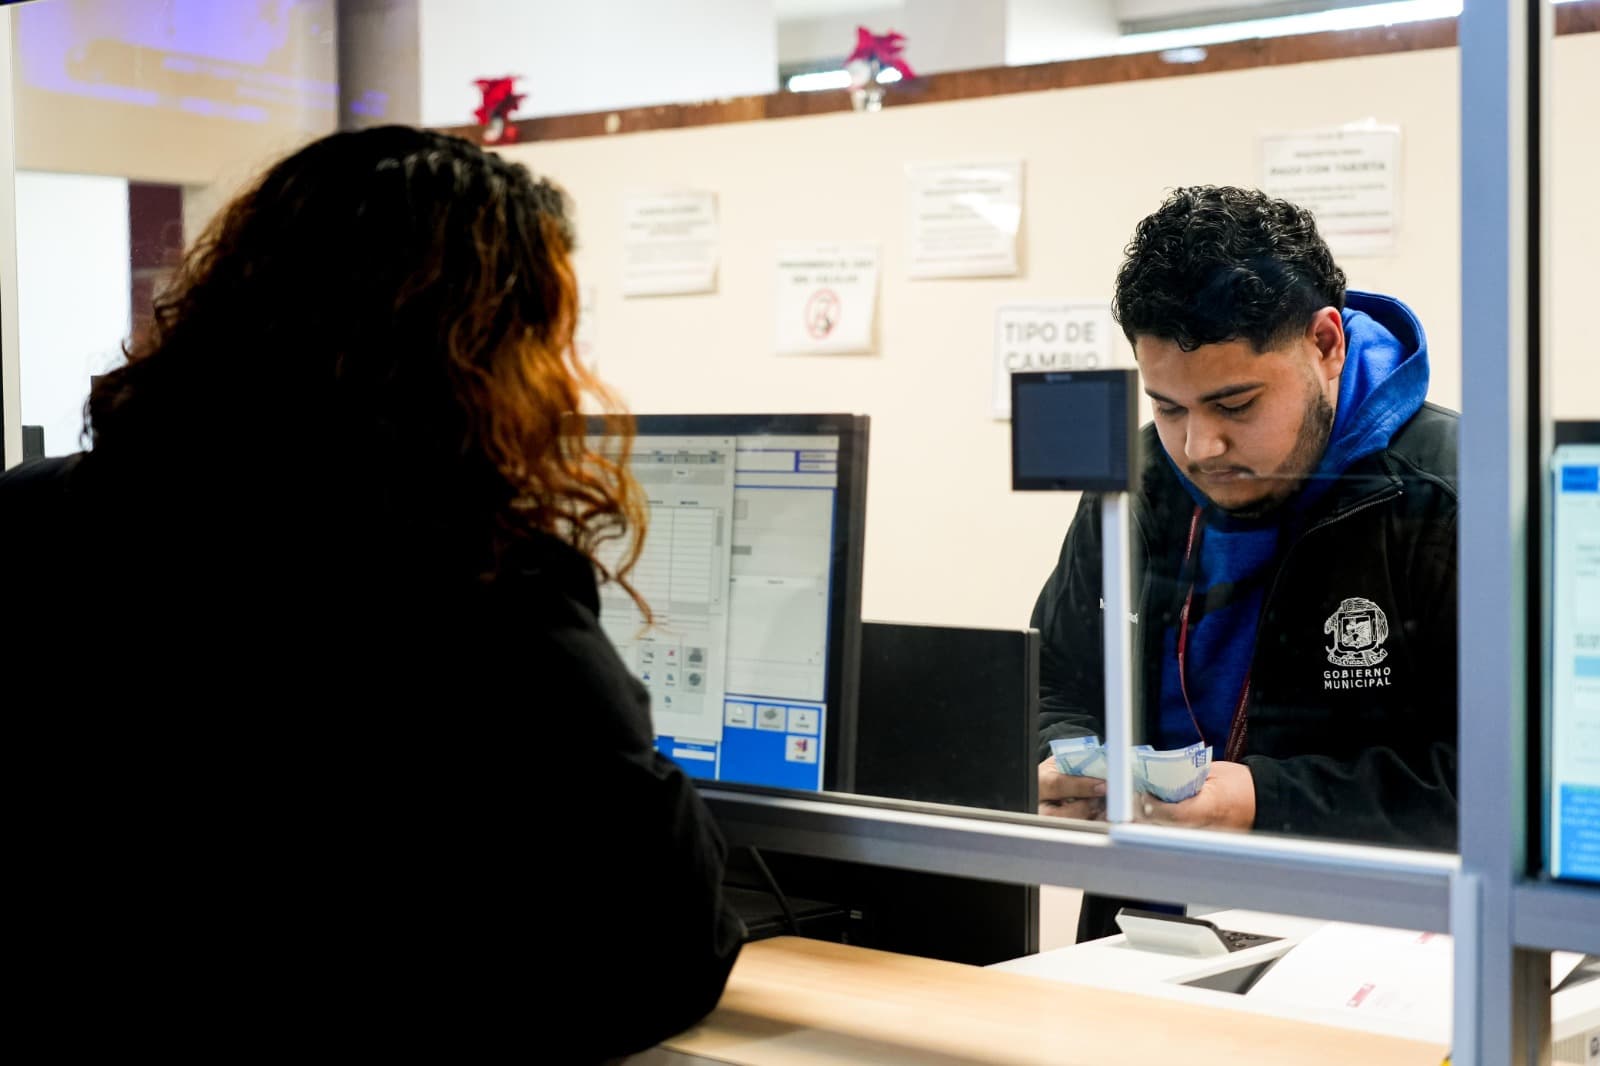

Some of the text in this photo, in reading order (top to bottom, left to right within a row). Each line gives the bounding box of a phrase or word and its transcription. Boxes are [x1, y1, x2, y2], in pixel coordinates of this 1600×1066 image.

[1004, 319, 1096, 343] TIPO DE
[1003, 351, 1098, 371] CAMBIO
[1323, 667, 1391, 679] GOBIERNO
[1323, 677, 1392, 690] MUNICIPAL
